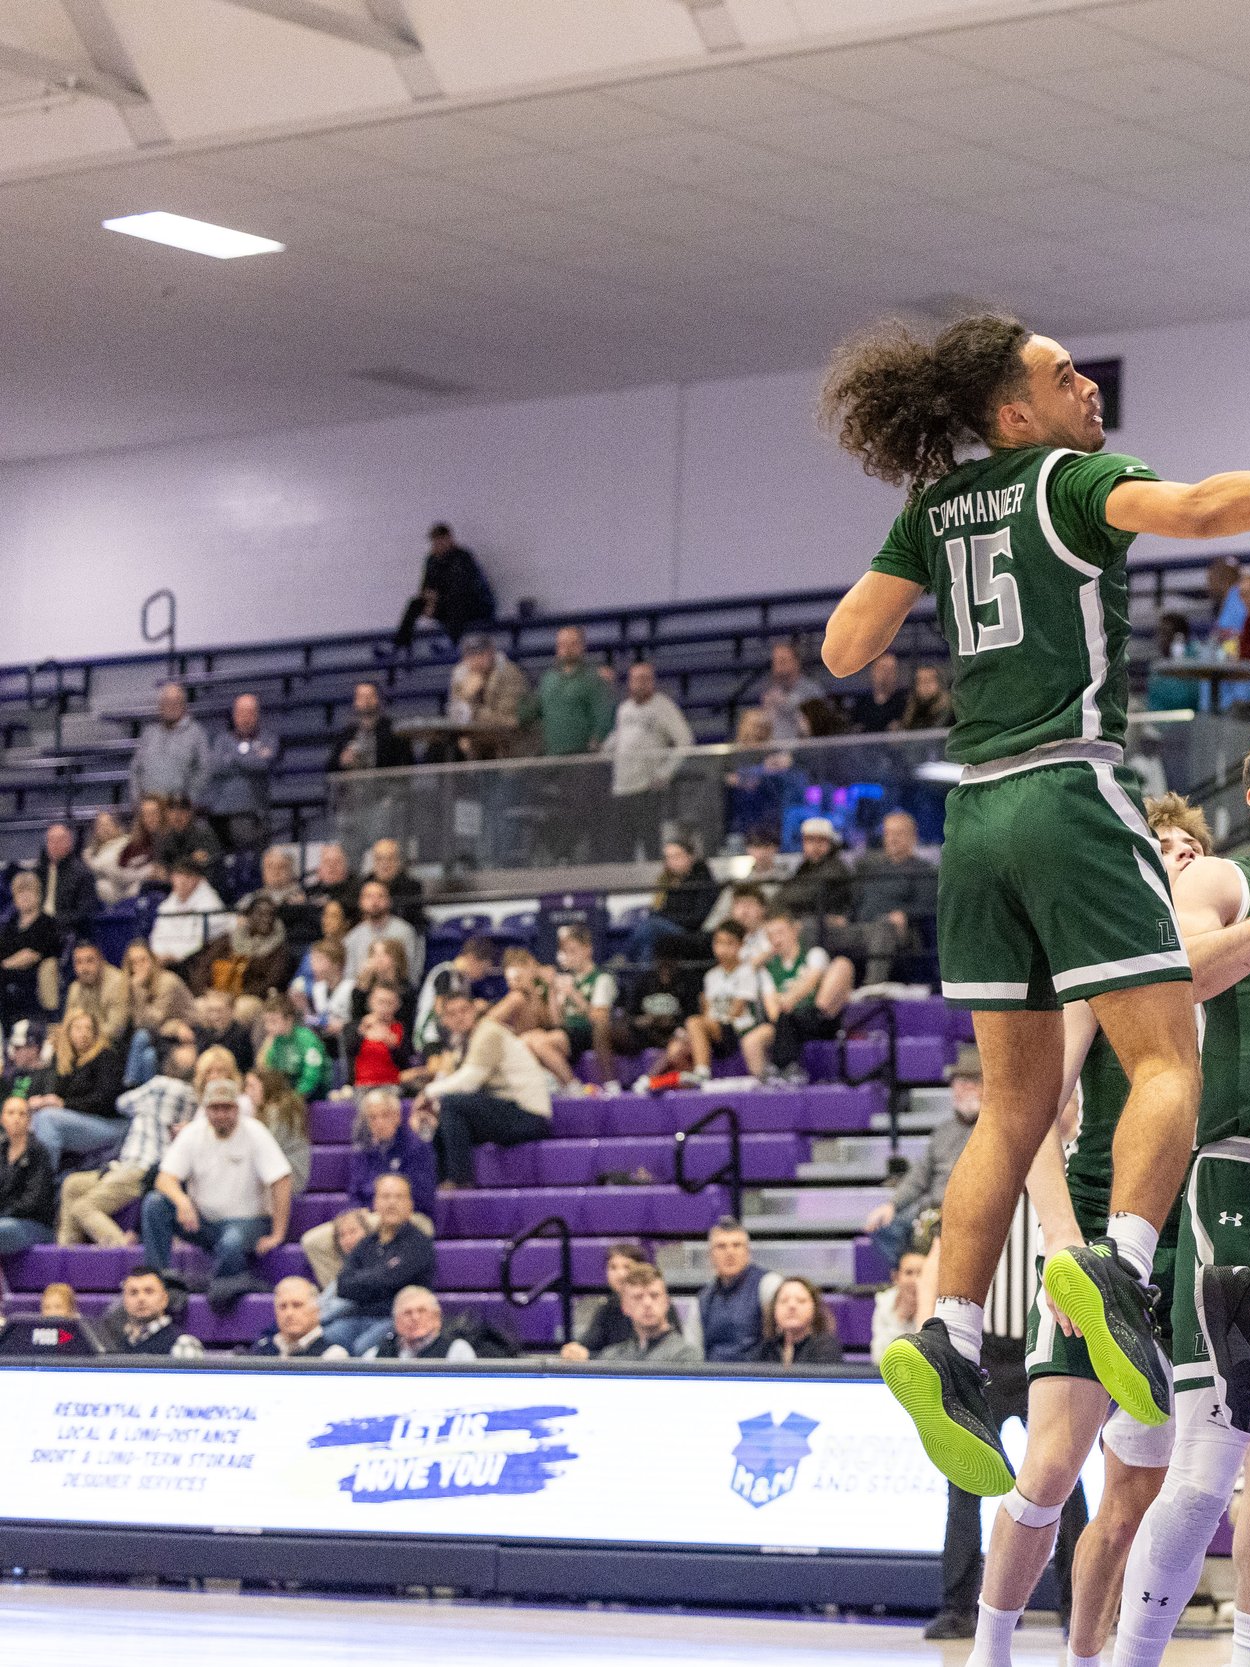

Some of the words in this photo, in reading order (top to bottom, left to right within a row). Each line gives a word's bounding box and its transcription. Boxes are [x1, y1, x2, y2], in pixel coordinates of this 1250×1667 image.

[928, 483, 1026, 537] COMMANDER
[945, 526, 1024, 656] 15
[390, 1416, 447, 1449] LET
[449, 1412, 489, 1446] US
[353, 1456, 431, 1492] MOVE
